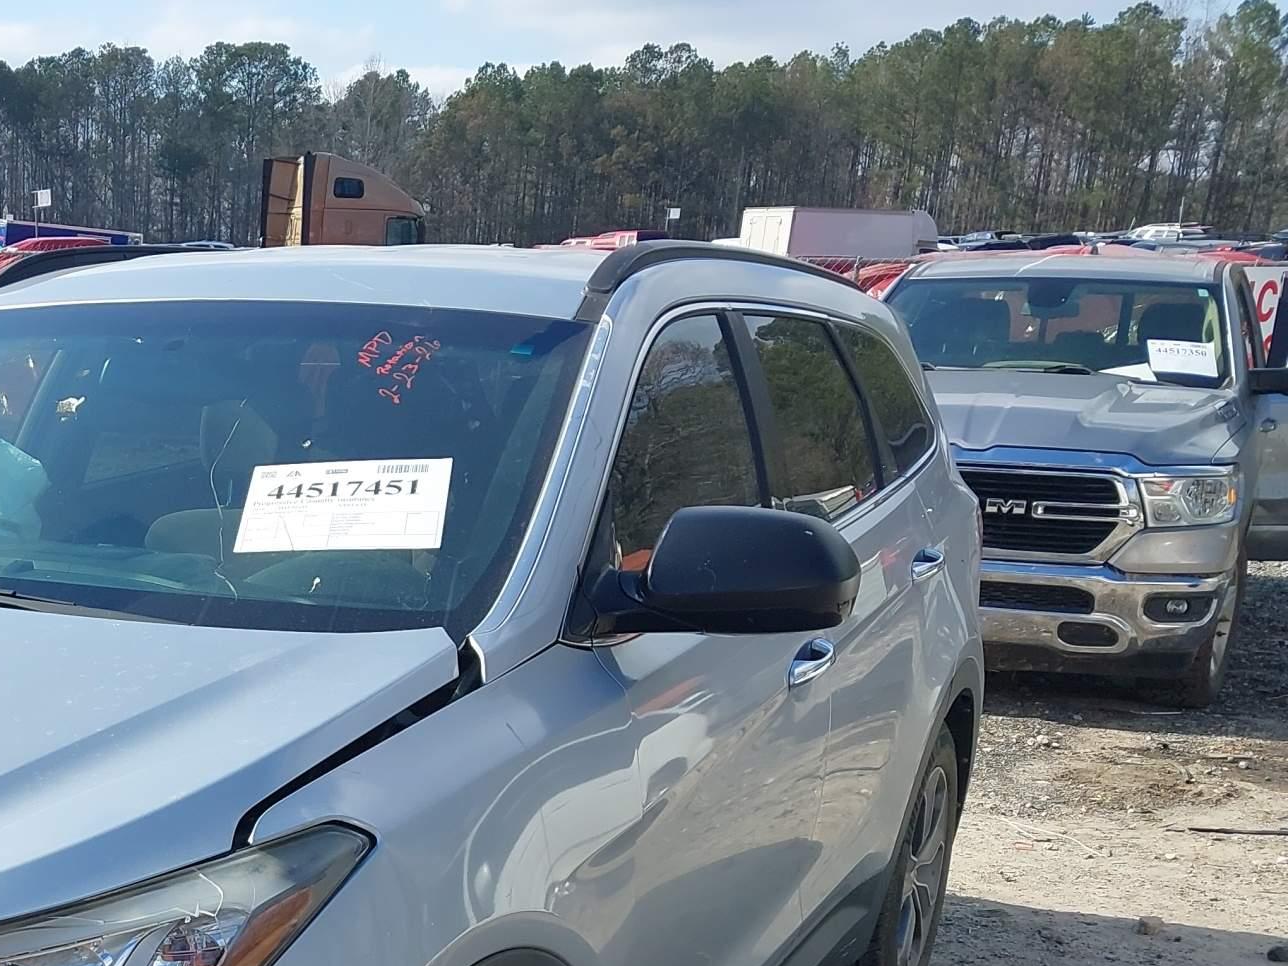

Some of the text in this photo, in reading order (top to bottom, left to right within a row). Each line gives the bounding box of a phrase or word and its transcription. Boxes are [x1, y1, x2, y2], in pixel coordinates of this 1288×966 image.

[357, 331, 393, 368] MPD
[378, 339, 441, 405] 2-23-26
[267, 479, 420, 499] 44517451
